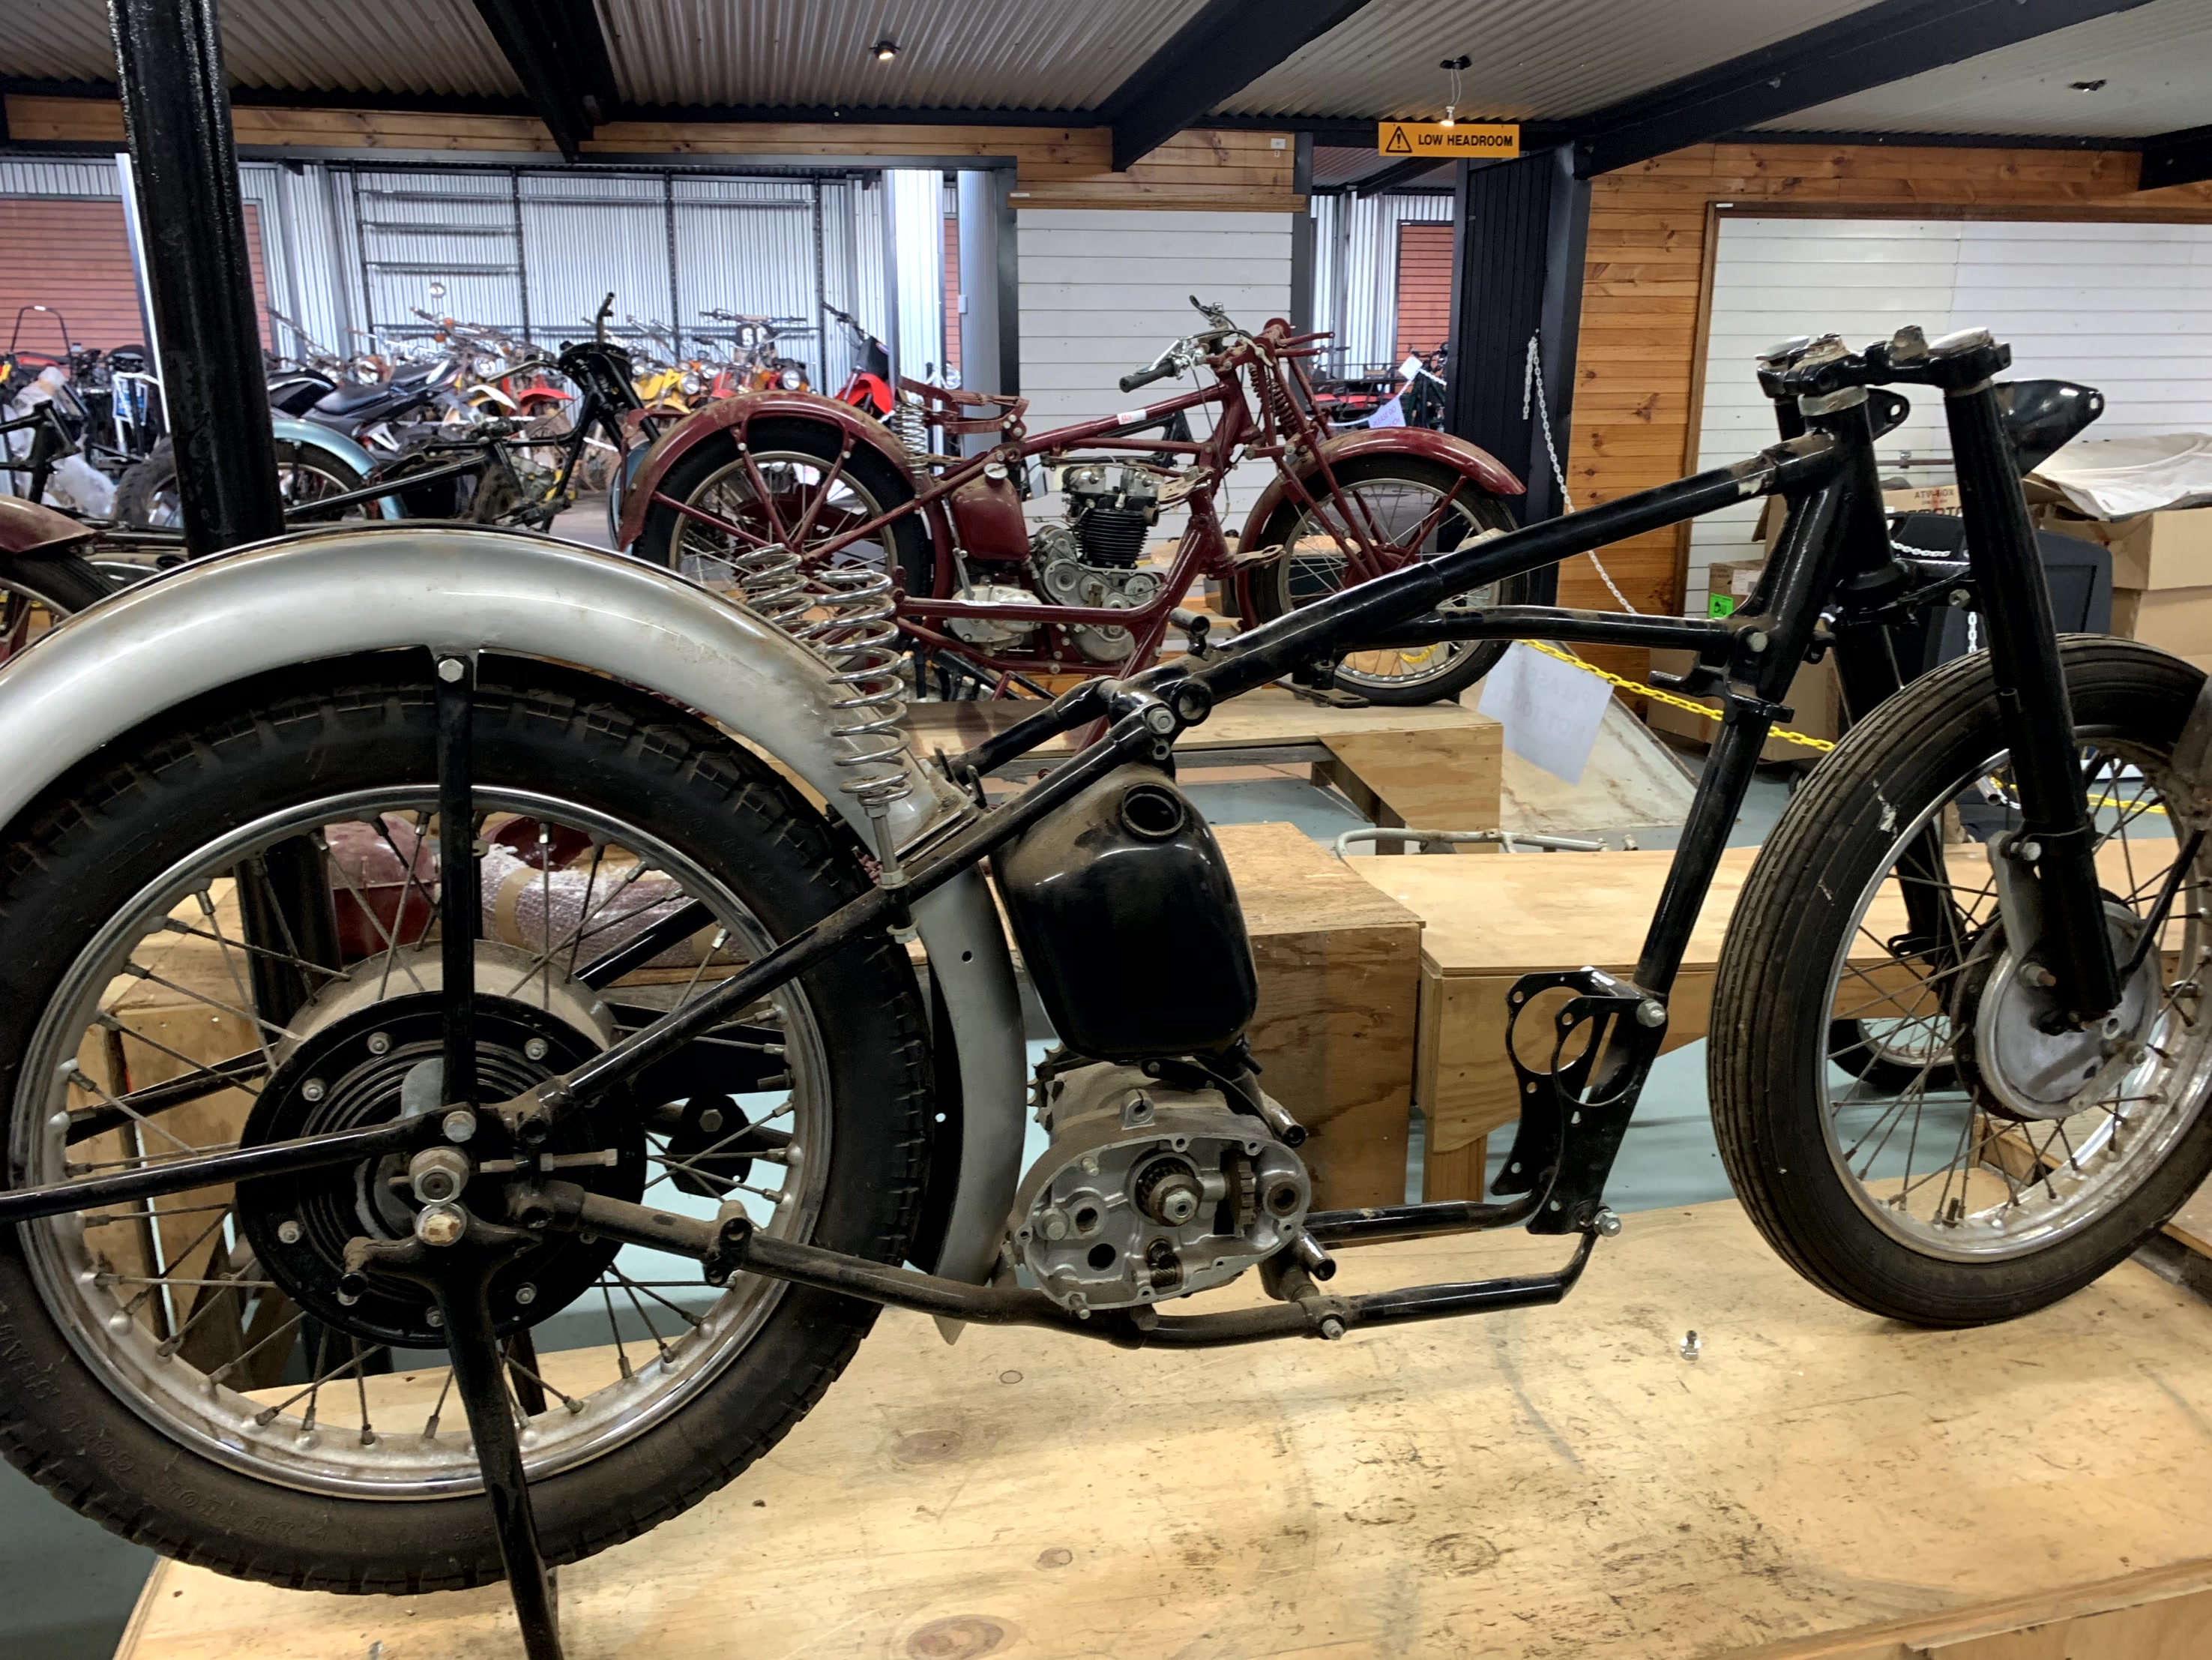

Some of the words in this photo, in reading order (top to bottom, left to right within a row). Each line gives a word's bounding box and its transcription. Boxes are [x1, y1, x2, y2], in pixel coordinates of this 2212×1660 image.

[1418, 134, 1443, 145] LOW
[1447, 134, 1513, 146] HEADROOM
[1388, 405, 1396, 415] DO
